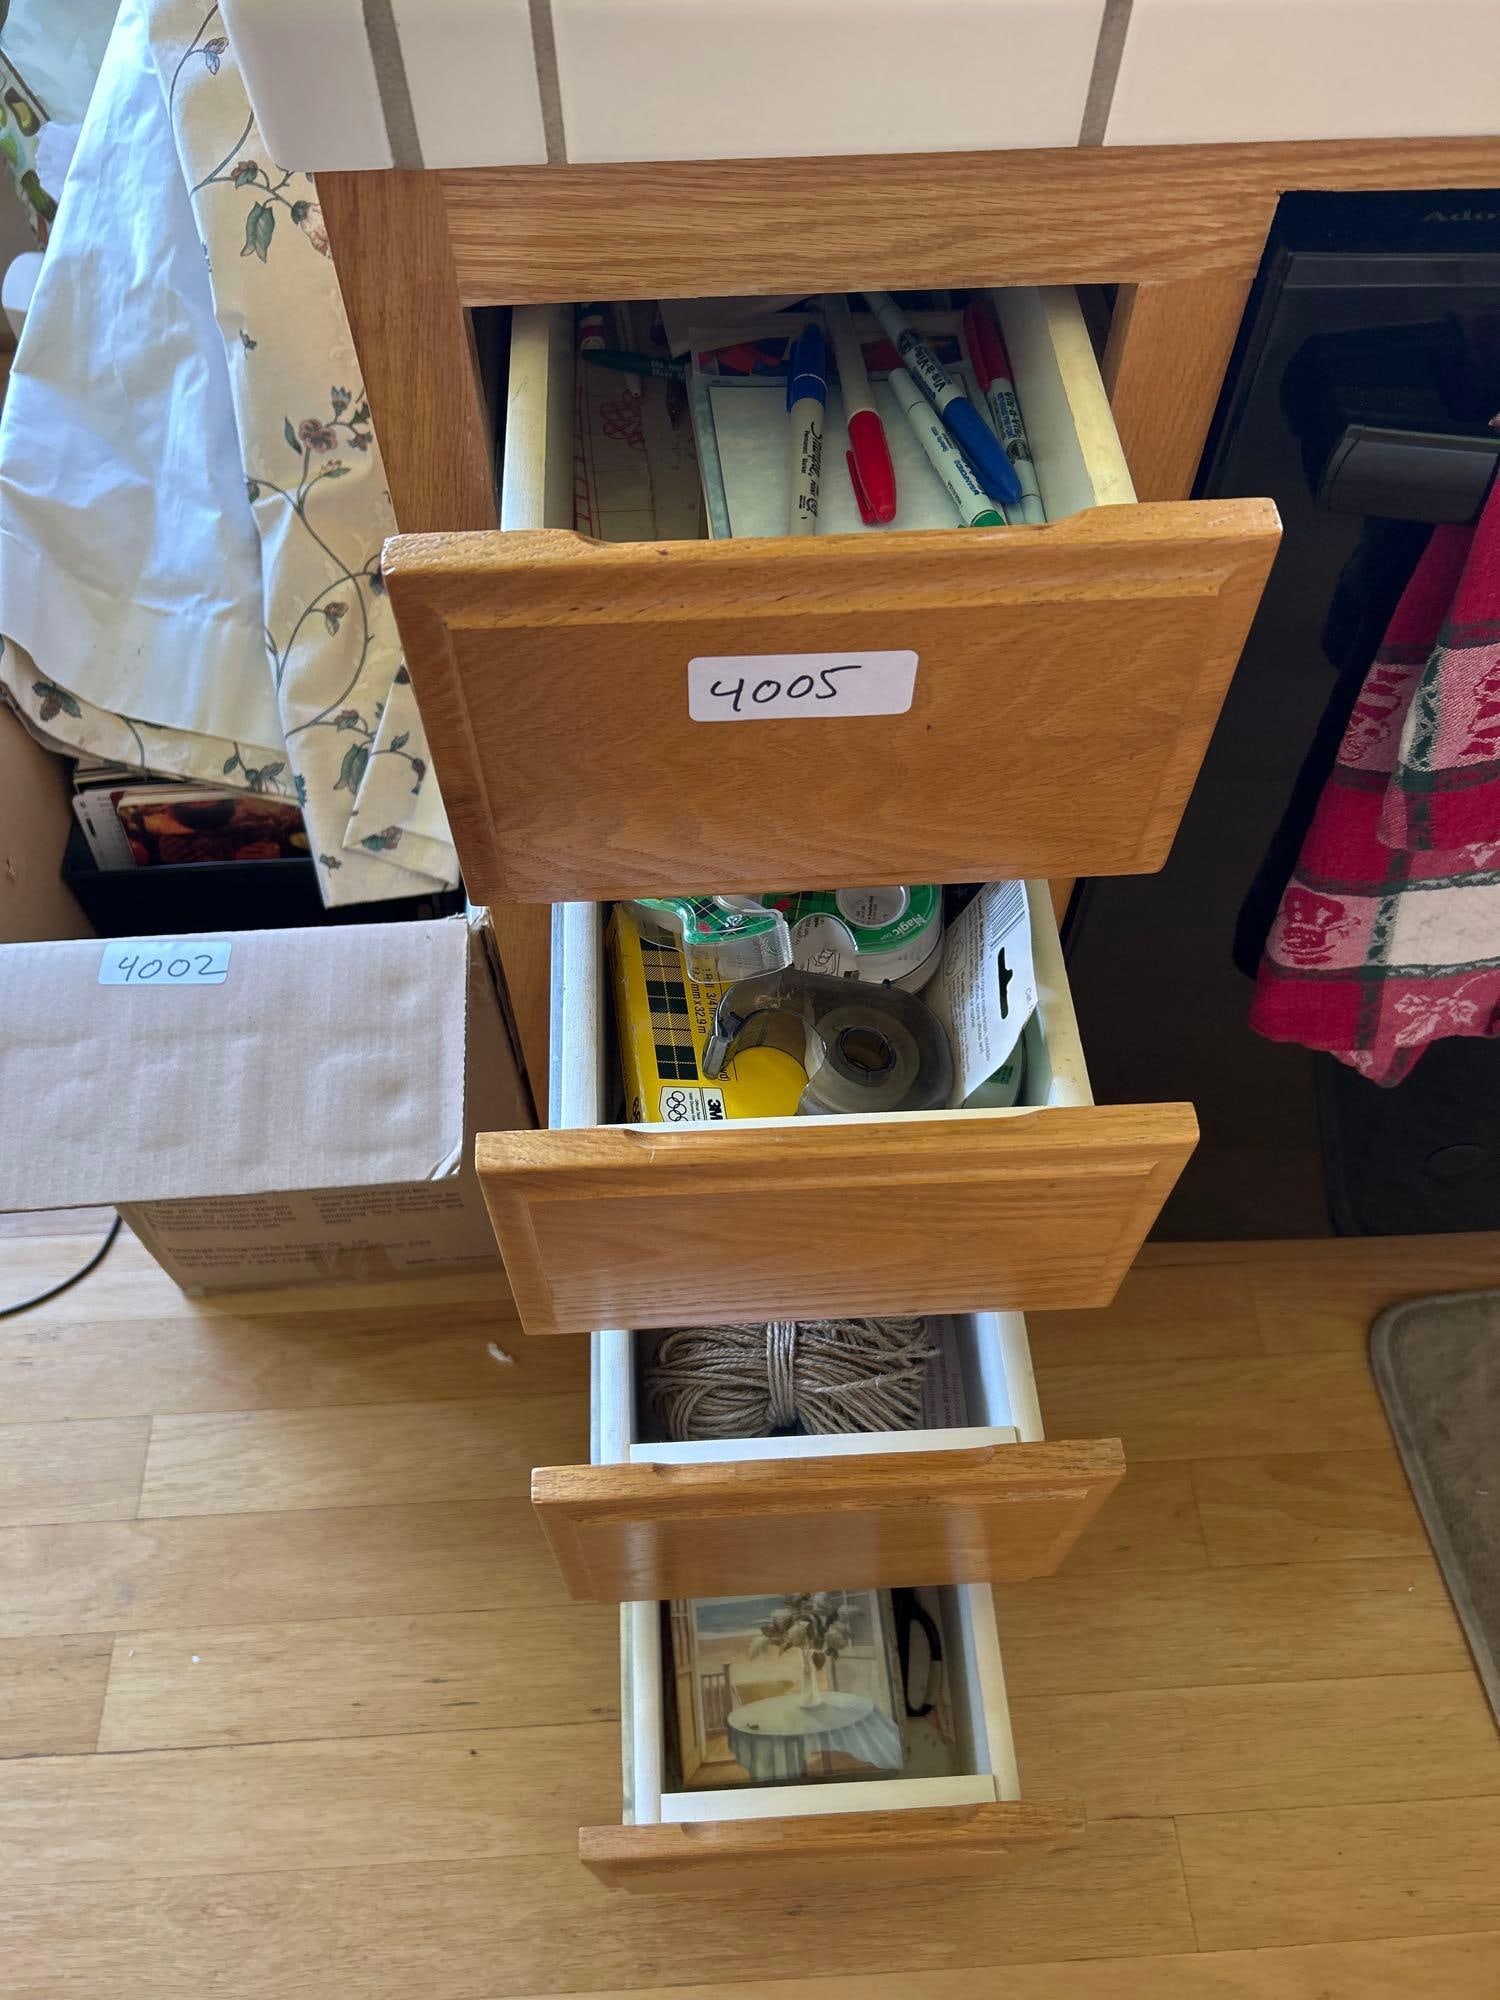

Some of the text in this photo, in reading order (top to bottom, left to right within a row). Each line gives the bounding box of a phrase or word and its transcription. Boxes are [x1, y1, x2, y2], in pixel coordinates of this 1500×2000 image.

[710, 665, 862, 712] 4005
[118, 954, 227, 982] 4002
[691, 983, 701, 998] mm
[694, 1007, 707, 1027] 32.9
[707, 1099, 723, 1120] 3M
